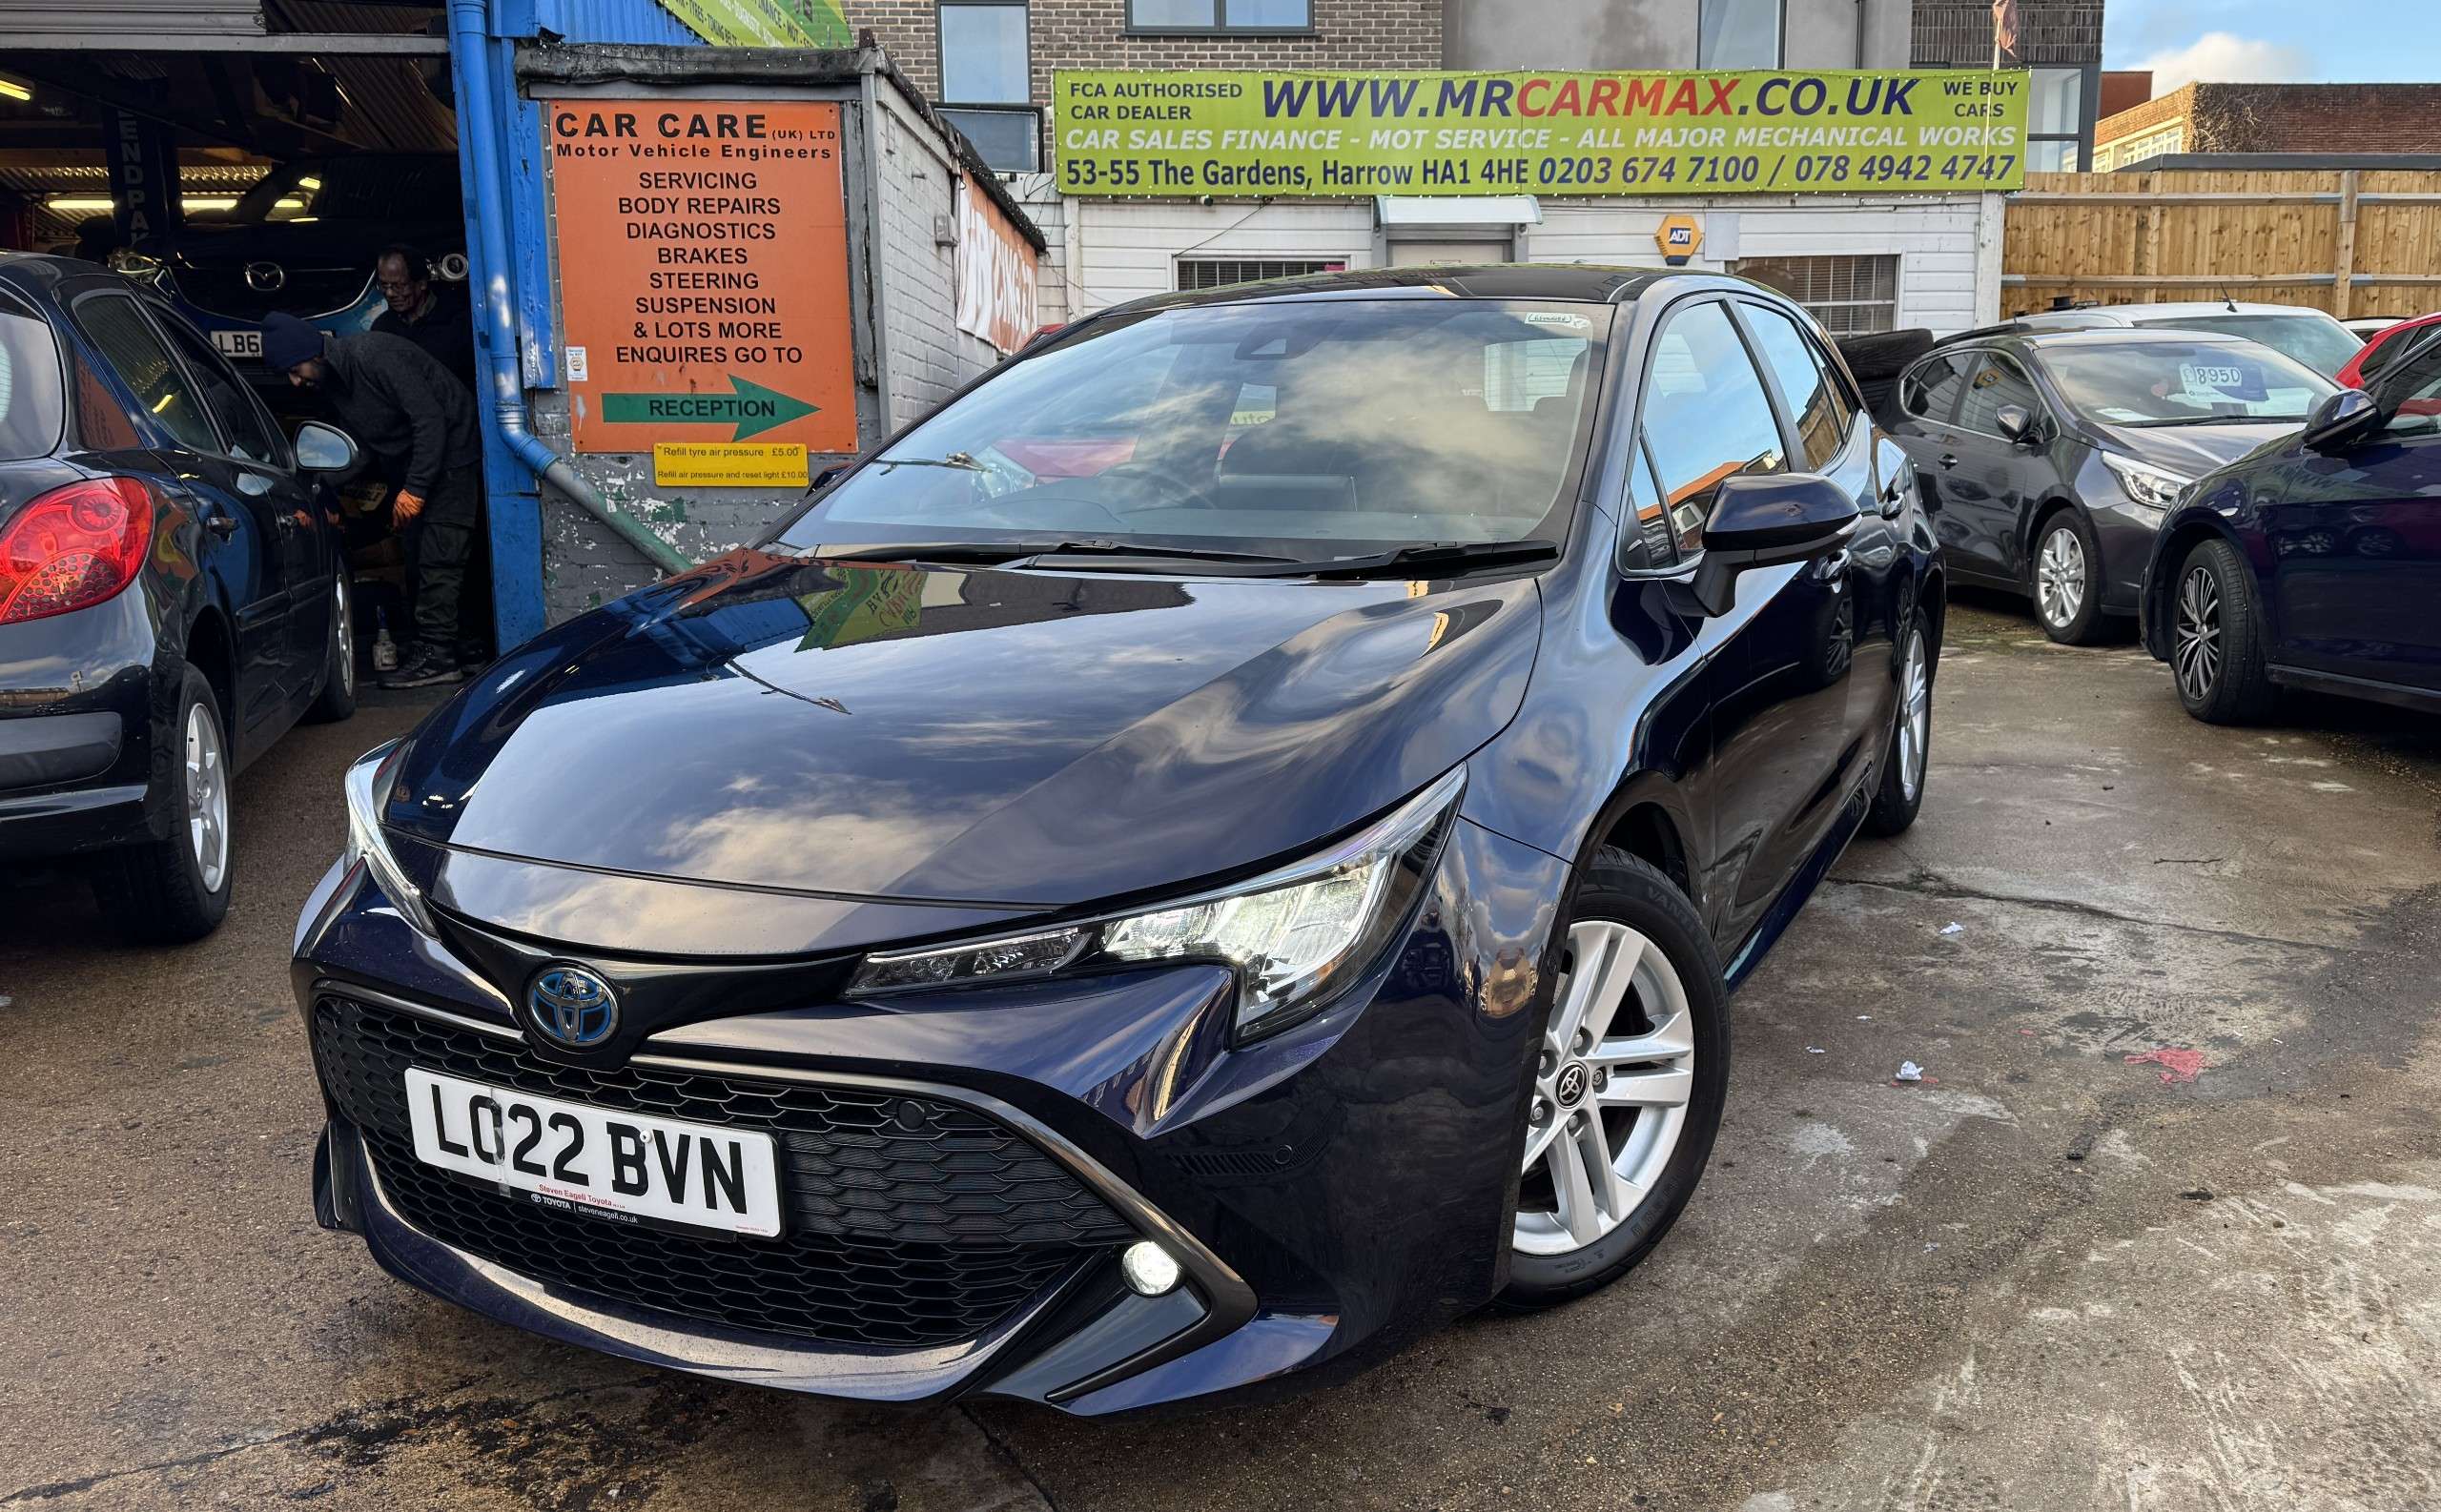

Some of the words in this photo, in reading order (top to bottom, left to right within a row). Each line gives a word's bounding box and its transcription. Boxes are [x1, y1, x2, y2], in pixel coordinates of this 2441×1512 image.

[1071, 83, 1106, 97] FCA
[1114, 84, 1241, 97] AUTHORISED
[1943, 81, 1973, 96] WE
[1981, 81, 2019, 96] BUY
[1263, 78, 1919, 119] WWW.MRCARMAX.CO.UK
[1071, 106, 1110, 119] CAR
[1118, 106, 1192, 119] DEALER
[1954, 103, 2004, 117] CARS
[555, 112, 638, 138] CAR
[659, 114, 767, 138] CARE
[772, 130, 804, 140] (UK)
[810, 130, 835, 140] LTD
[1065, 129, 1124, 150] CAR
[1128, 129, 1213, 150] SALES
[1220, 128, 1342, 150] FINANCE
[1369, 129, 1429, 150] MOT
[1434, 129, 1549, 149] SERVICE
[1575, 128, 1625, 148] ALL
[1634, 127, 1726, 148] MAJOR
[1735, 127, 1907, 147] MECHANICAL
[1918, 126, 2016, 146] WORKS
[556, 143, 619, 157] Motor
[631, 144, 711, 158] Vehicle
[721, 145, 831, 161] Engineers
[640, 173, 756, 189] SERVICING
[1066, 159, 1139, 186] 53-55
[1148, 160, 1198, 186] The
[1202, 160, 1311, 191] Gardens,
[1323, 160, 1412, 185] Harrow
[1422, 160, 1470, 185] HA1
[1481, 159, 1529, 184] 4HE
[1539, 156, 1611, 184] 0203
[1622, 156, 1676, 184] 674
[1686, 155, 1759, 183] 7100
[1795, 155, 1848, 182] 078
[1858, 155, 1932, 181] 4942
[1941, 155, 2016, 180] 4747
[619, 197, 679, 214] BODY
[687, 198, 780, 215] REPAIRS
[627, 223, 775, 239] DIAGNOSTICS
[1670, 229, 1691, 242] ADT
[658, 248, 748, 264] BRAKES
[650, 273, 758, 289] STEERING
[636, 297, 775, 314] SUSPENSION
[634, 322, 647, 337] &
[655, 322, 710, 337] LOTS
[719, 322, 782, 338] MORE
[616, 346, 727, 365] ENQUIRES
[734, 347, 766, 364] GO
[773, 347, 803, 363] TO
[649, 399, 775, 418] RECEPTION
[689, 449, 707, 458] tyre
[431, 1084, 589, 1187] LO22
[606, 1120, 748, 1215] BVN
[540, 1184, 563, 1195] Steven
[564, 1190, 585, 1200] Eagell
[587, 1195, 611, 1206] Toyota
[542, 1196, 571, 1209] TOYOTA
